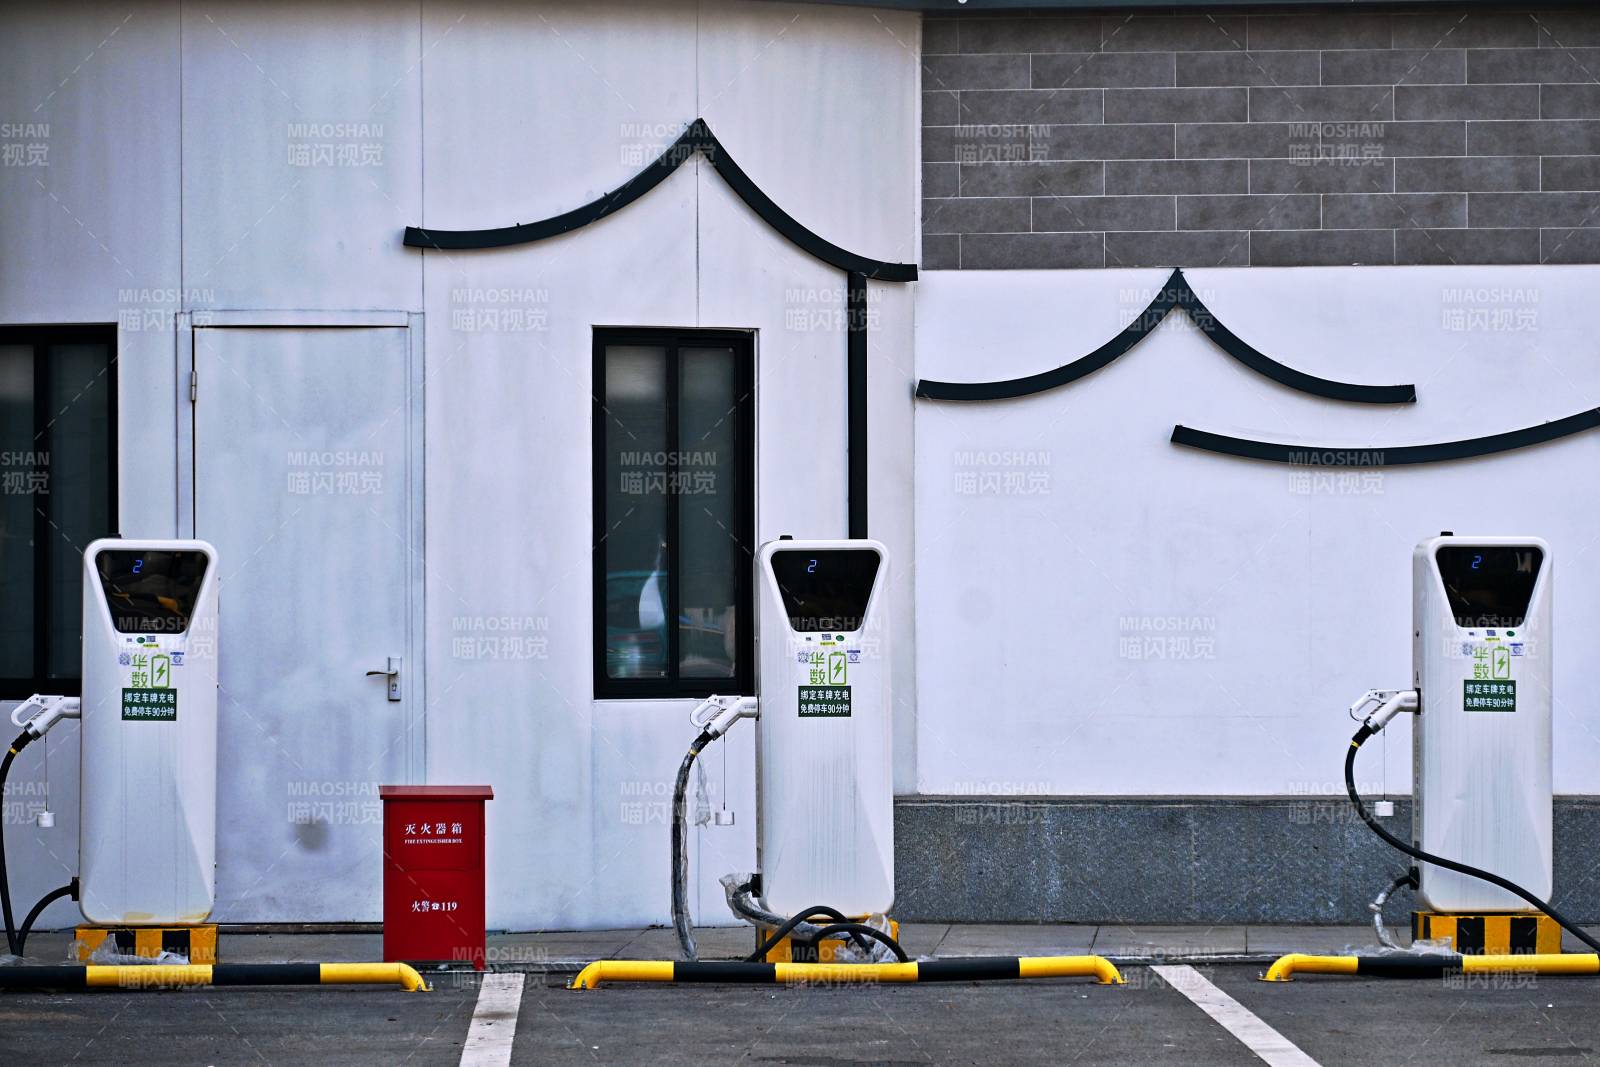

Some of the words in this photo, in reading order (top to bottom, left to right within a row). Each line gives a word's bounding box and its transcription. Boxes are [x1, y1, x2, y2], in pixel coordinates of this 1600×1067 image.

[132, 559, 143, 573] 2
[807, 559, 817, 573] 2
[1472, 555, 1482, 569] 2
[809, 651, 826, 685] 华数
[1473, 646, 1489, 680] 华数
[132, 653, 148, 688] 华数
[800, 689, 850, 701] 绑定车牌充电
[1466, 684, 1515, 695] 绑定车牌充电
[124, 692, 175, 704] 绑定车牌充电
[1466, 697, 1515, 708] 免费停车90分钟
[124, 706, 175, 717] 免费停车90分钟
[800, 703, 850, 714] 免费停车90分钟
[404, 823, 462, 835] 灭火器箱
[441, 901, 458, 911] 119
